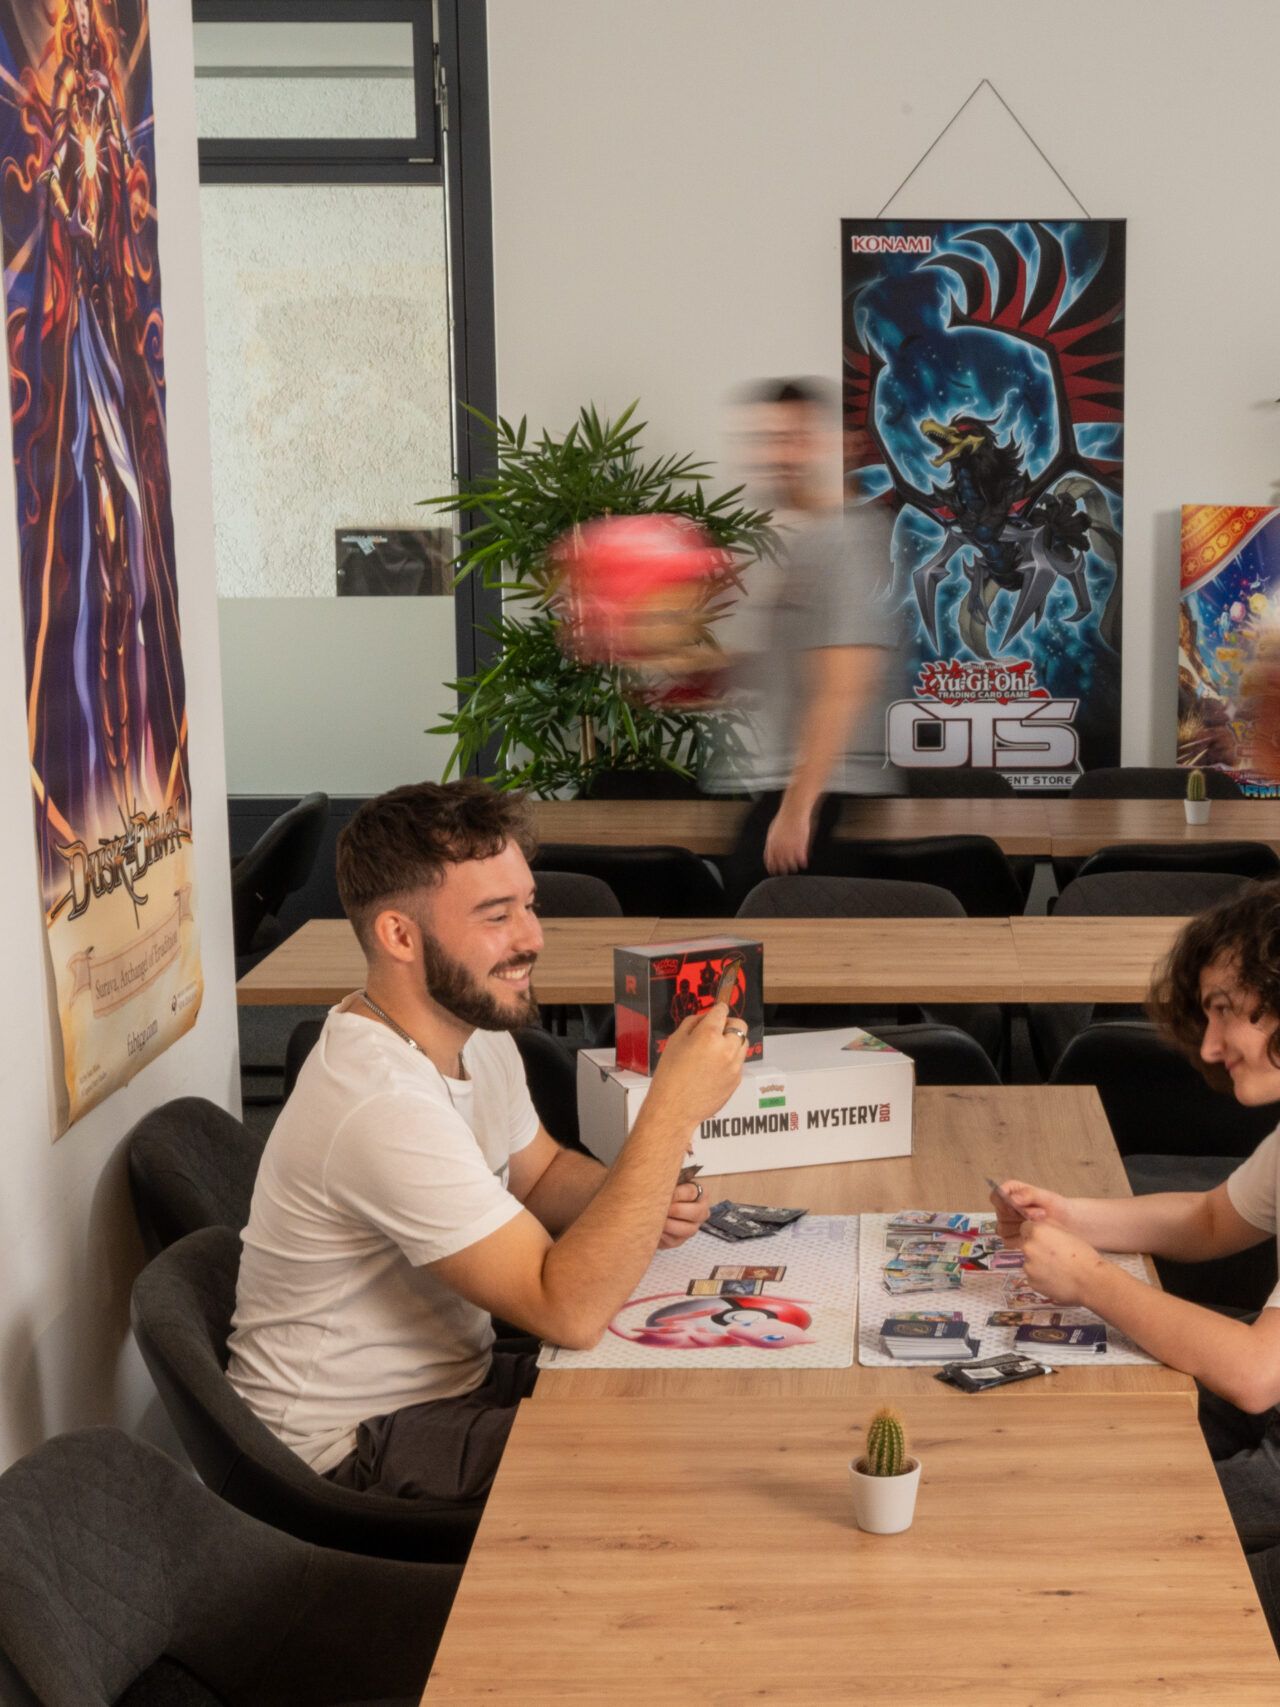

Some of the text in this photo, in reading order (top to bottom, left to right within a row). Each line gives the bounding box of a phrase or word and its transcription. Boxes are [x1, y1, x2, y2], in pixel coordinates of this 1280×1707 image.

[851, 235, 931, 253] KONAMI
[938, 691, 976, 699] TRADING
[978, 691, 1002, 699] CARD
[888, 701, 1079, 768] OTS
[1033, 776, 1072, 785] STORE
[700, 1112, 790, 1139] UNCOMMON
[807, 1104, 879, 1129] MYSTERY
[879, 1103, 891, 1122] BOX
